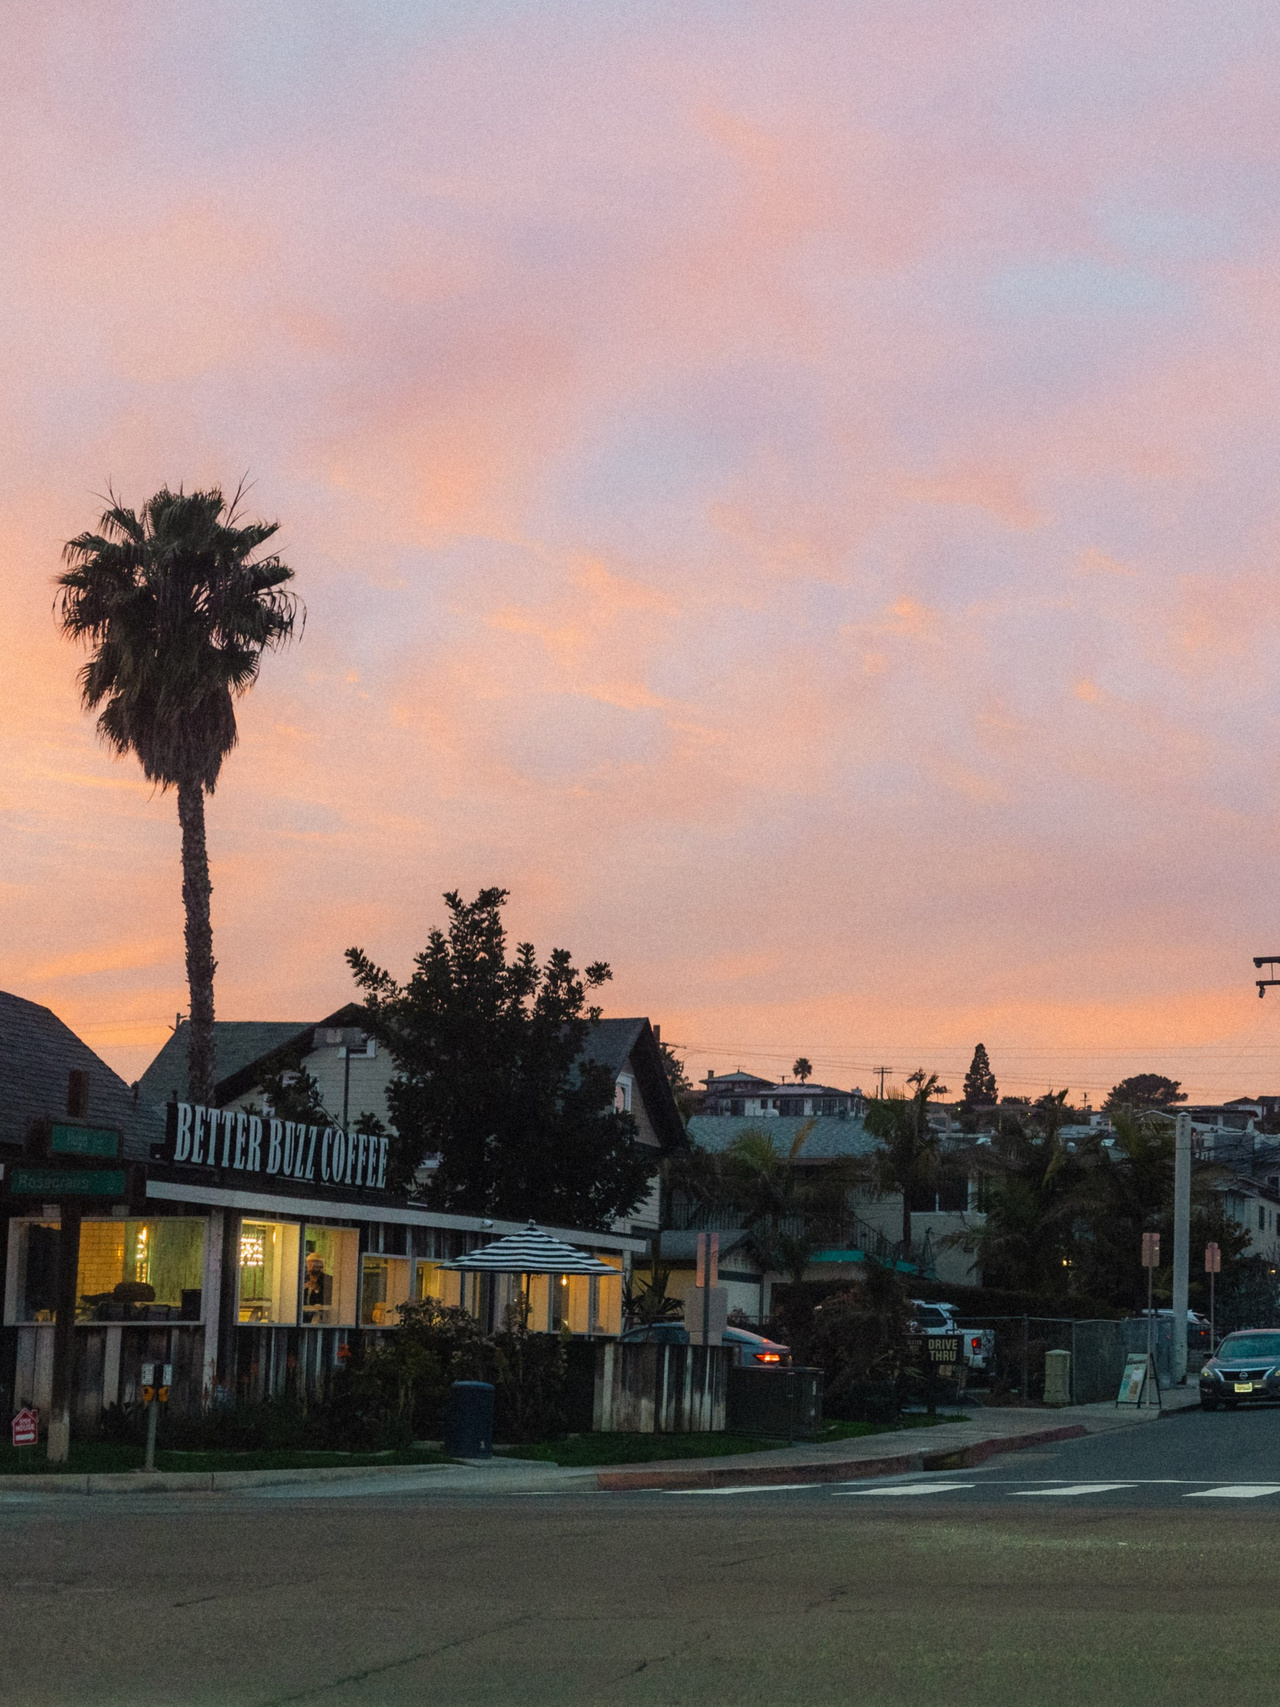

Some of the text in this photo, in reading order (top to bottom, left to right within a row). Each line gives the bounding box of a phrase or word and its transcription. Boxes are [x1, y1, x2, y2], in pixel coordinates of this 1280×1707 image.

[173, 1102, 389, 1189] BETTER BUZZ COFFEE
[18, 1173, 90, 1190] Rosecrans
[927, 1338, 958, 1350] DRIVE
[929, 1350, 957, 1361] THRU
[15, 1423, 35, 1432] HOUSE
